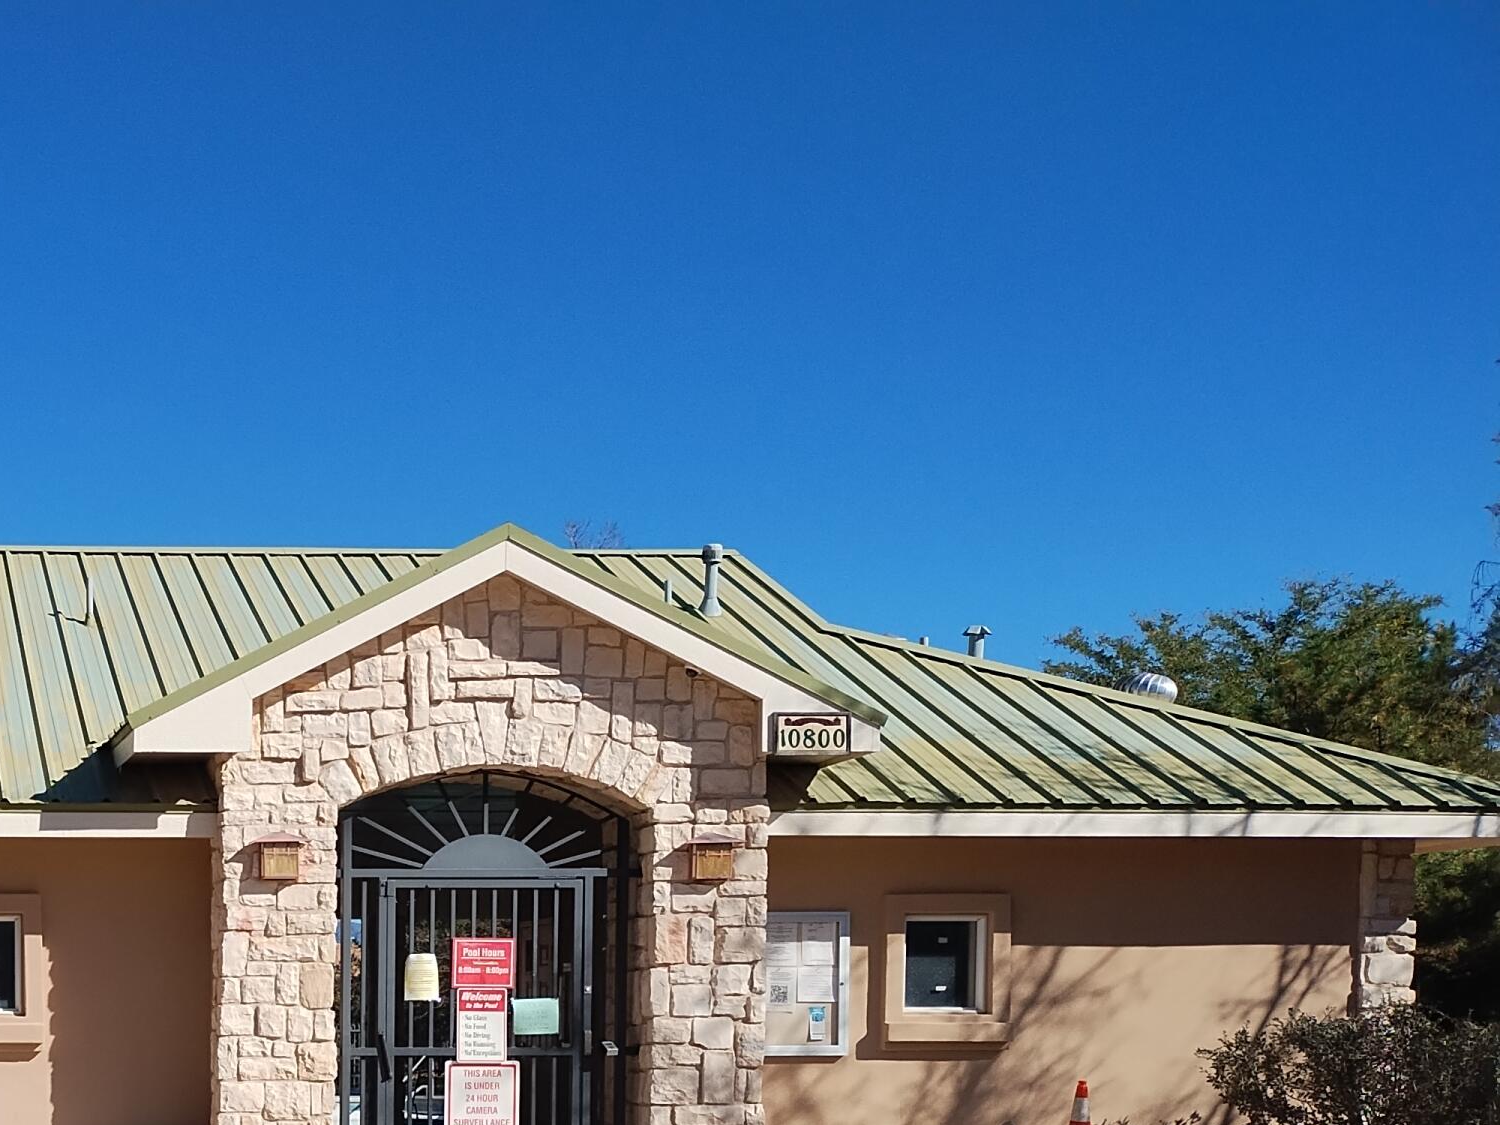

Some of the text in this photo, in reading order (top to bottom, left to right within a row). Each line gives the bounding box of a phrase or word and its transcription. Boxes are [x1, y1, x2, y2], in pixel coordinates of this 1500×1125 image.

[780, 728, 846, 749] 10800
[463, 947, 505, 957] Pool Hours
[461, 991, 502, 1002] Welcome
[464, 1069, 502, 1078] THIS AREA
[464, 1081, 500, 1090] IS UNDER
[466, 1094, 499, 1102] 24 HOUR
[466, 1106, 498, 1115] CAMERA
